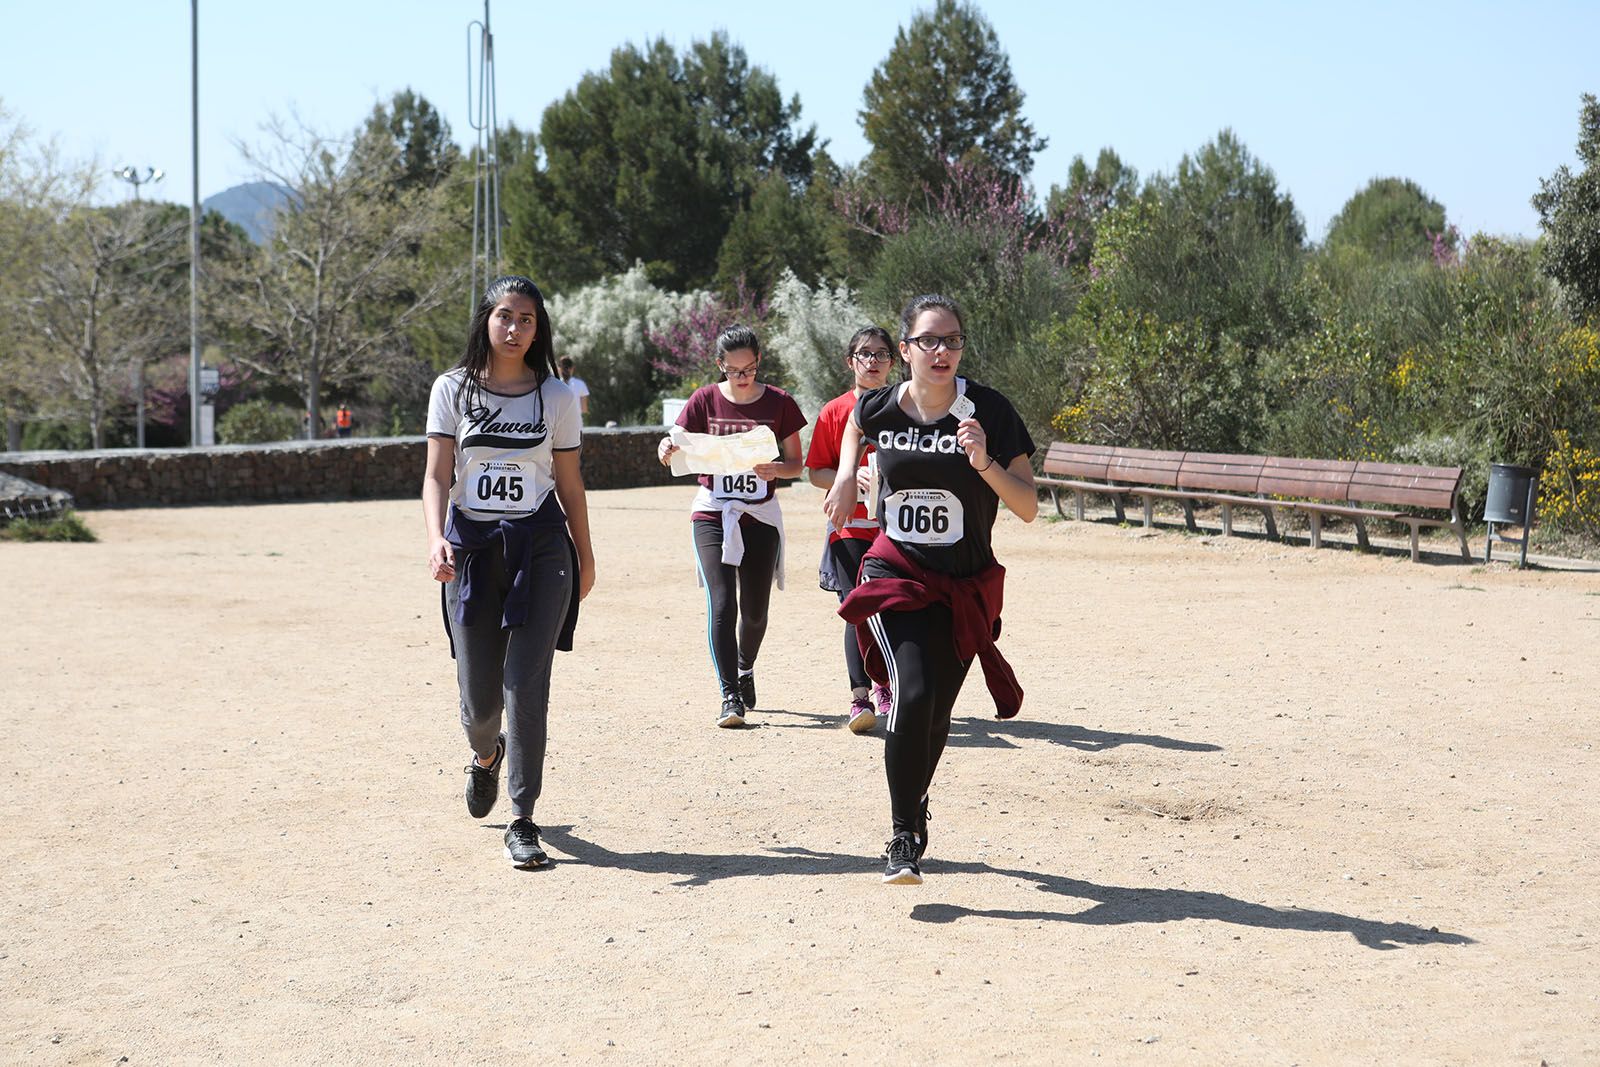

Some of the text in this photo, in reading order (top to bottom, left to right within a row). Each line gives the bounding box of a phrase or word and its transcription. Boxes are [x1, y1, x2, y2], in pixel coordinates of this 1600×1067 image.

[477, 475, 524, 502] 045
[722, 475, 758, 494] 045
[898, 504, 949, 534] 066
